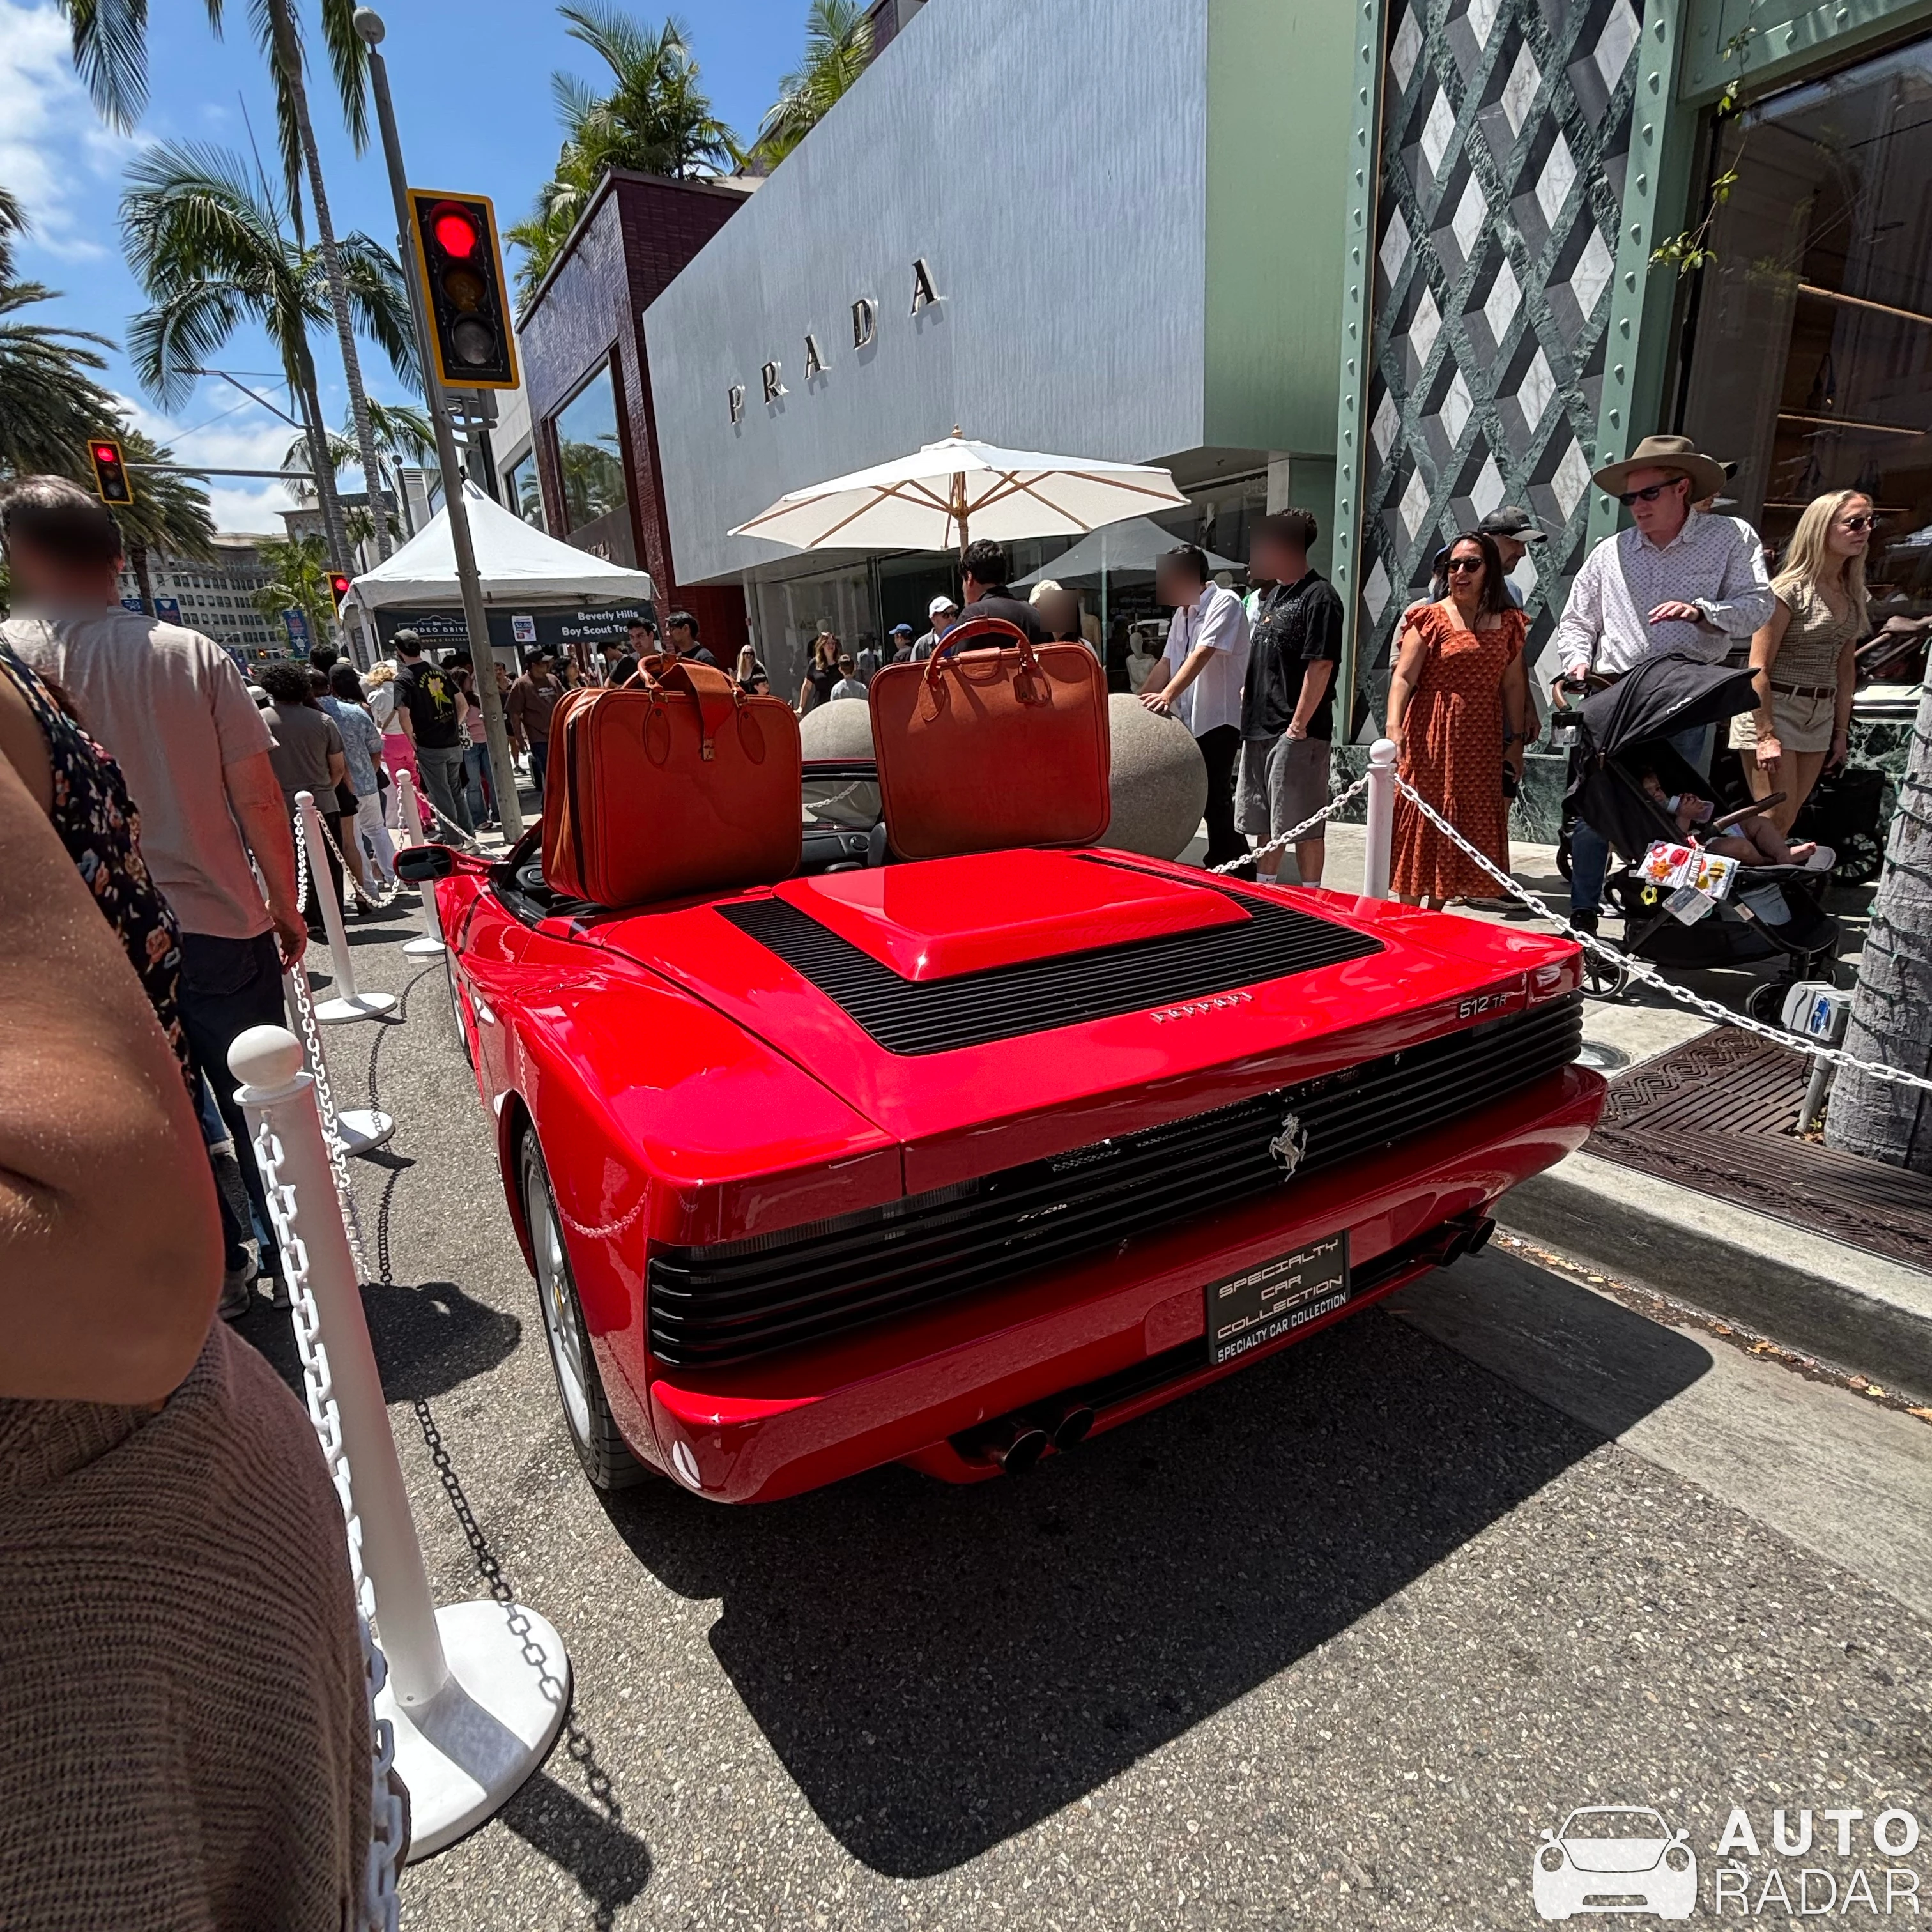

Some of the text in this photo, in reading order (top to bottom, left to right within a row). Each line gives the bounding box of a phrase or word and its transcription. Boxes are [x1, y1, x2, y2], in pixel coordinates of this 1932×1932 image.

[728, 258, 940, 425] PRADA
[562, 624, 627, 637] Boy Scout Tro
[578, 610, 638, 621] Beverly Hills
[1459, 995, 1507, 1018] 512 TR
[1219, 1239, 1338, 1298] SPECIALTY
[1261, 1275, 1301, 1300] CAR
[1218, 1275, 1342, 1340] COLLECTION
[1218, 1292, 1346, 1363] SPECIALTY CAR COLLECTION
